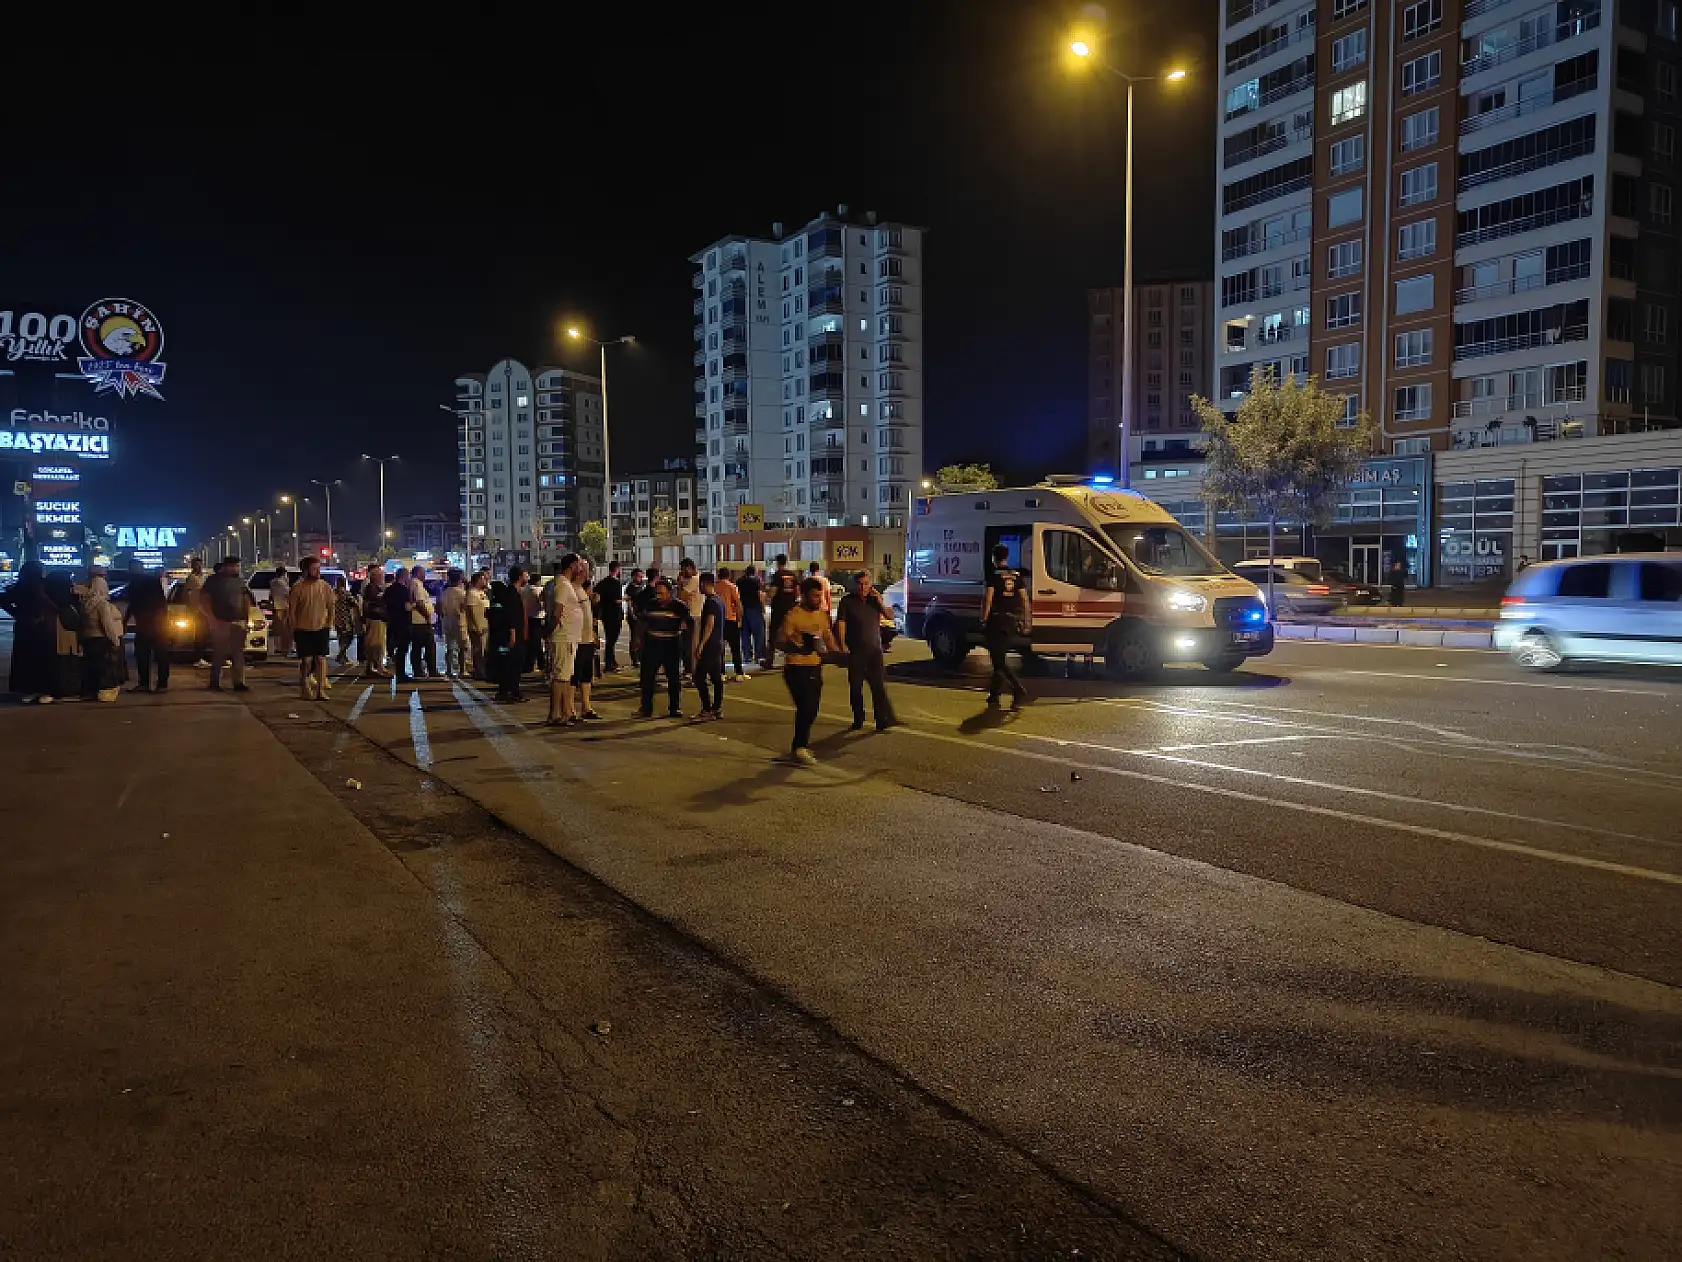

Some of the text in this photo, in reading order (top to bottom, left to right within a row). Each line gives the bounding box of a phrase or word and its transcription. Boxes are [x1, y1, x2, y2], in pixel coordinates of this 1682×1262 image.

[0, 310, 77, 343] 100
[0, 431, 109, 453] BAŞYAZICI
[36, 501, 80, 512] SUCUK
[36, 514, 81, 523] EKMEK
[117, 527, 179, 550] ANA
[936, 556, 961, 575] 112
